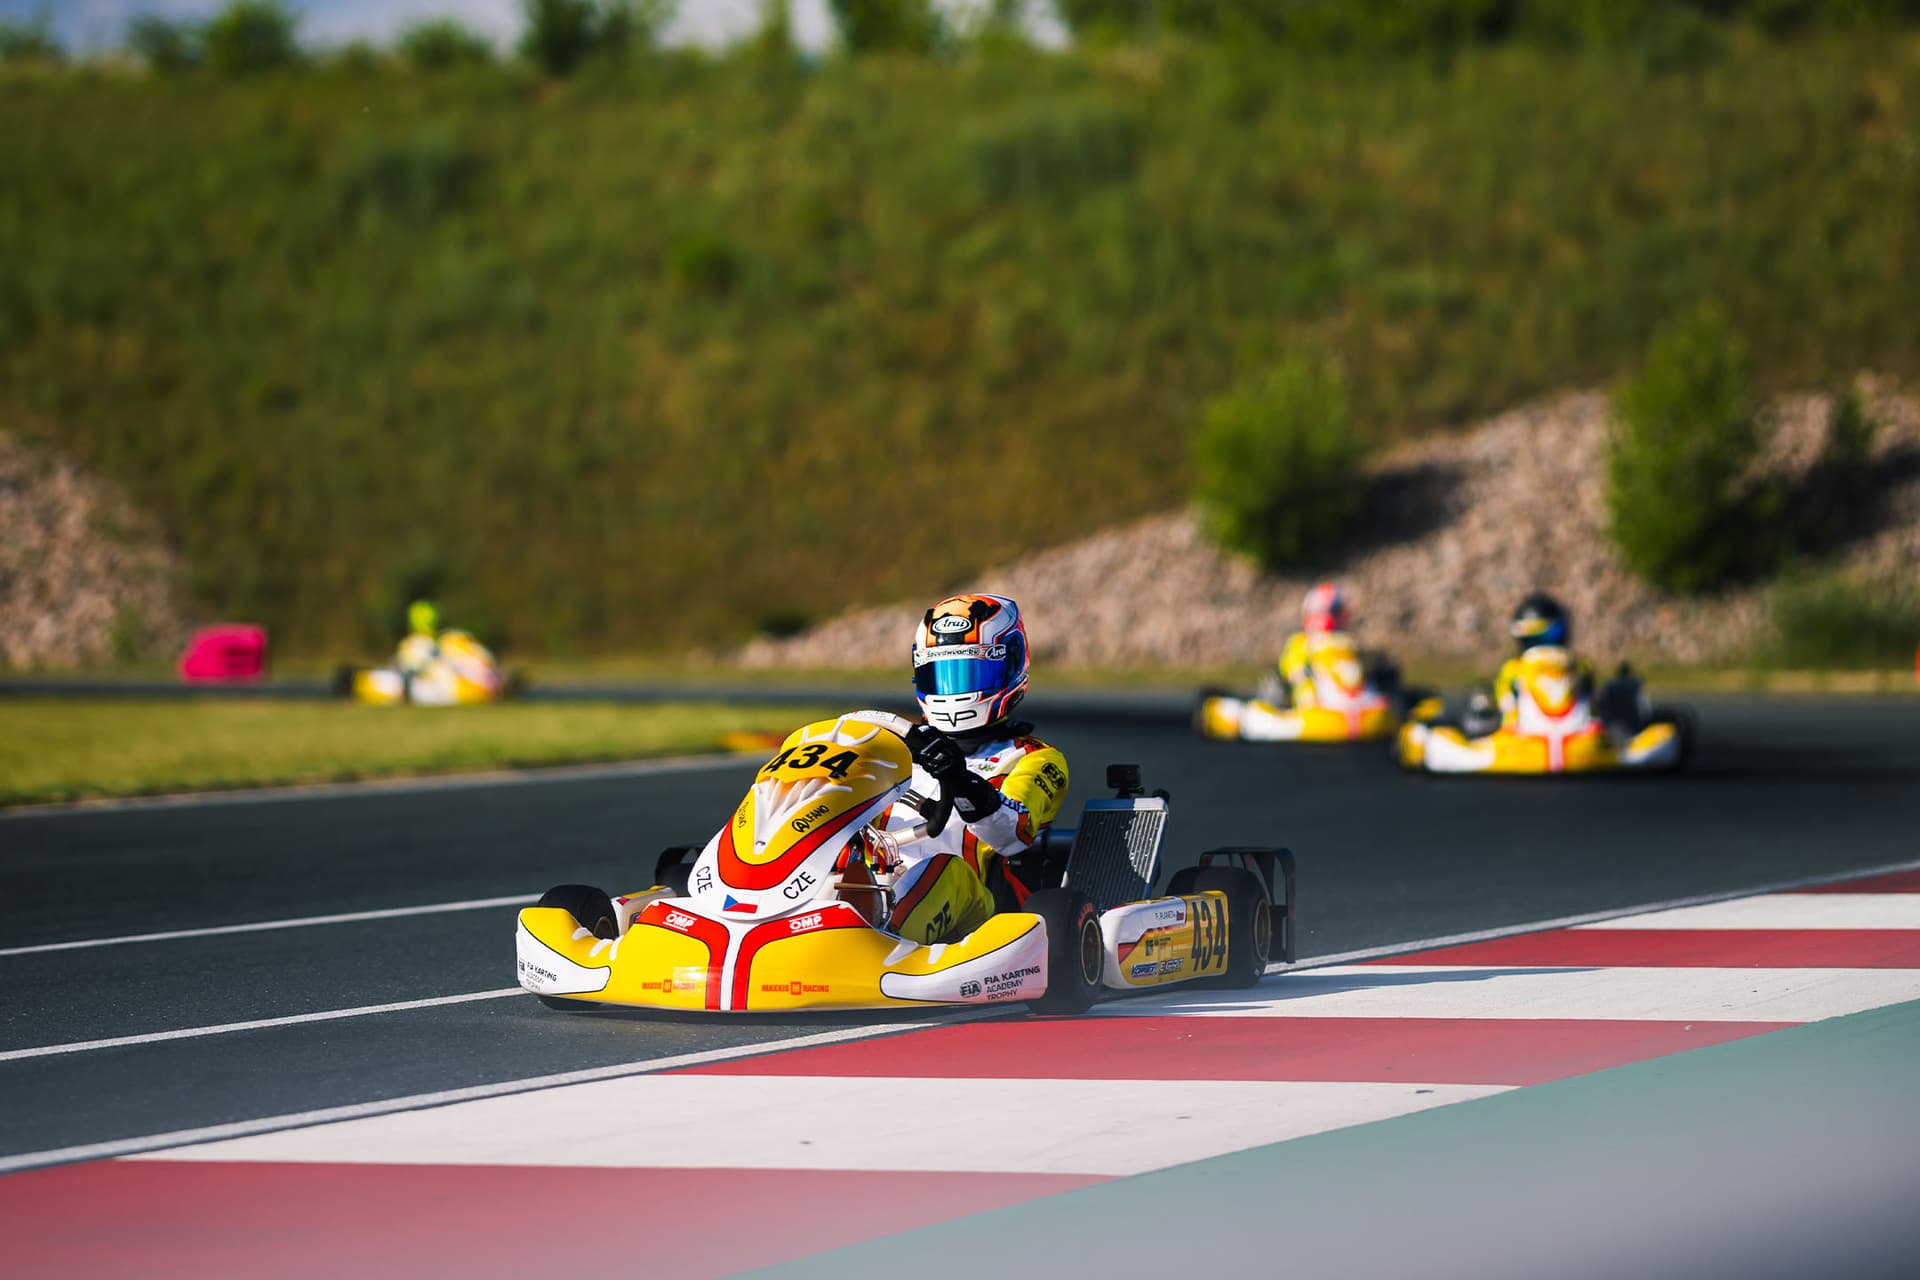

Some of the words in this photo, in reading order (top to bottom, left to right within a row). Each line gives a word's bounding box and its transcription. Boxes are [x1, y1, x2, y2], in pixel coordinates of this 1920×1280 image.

[763, 744, 860, 779] 434
[696, 866, 713, 894] CZE
[783, 871, 816, 899] CZE
[664, 912, 695, 929] OMP
[790, 915, 822, 930] OMP
[1191, 899, 1226, 972] 434
[984, 975, 1000, 986] FIA
[1001, 966, 1041, 982] KARTING
[961, 982, 980, 996] FIA
[986, 979, 1023, 994] ACADEMY
[987, 989, 1018, 1001] TROPHY
